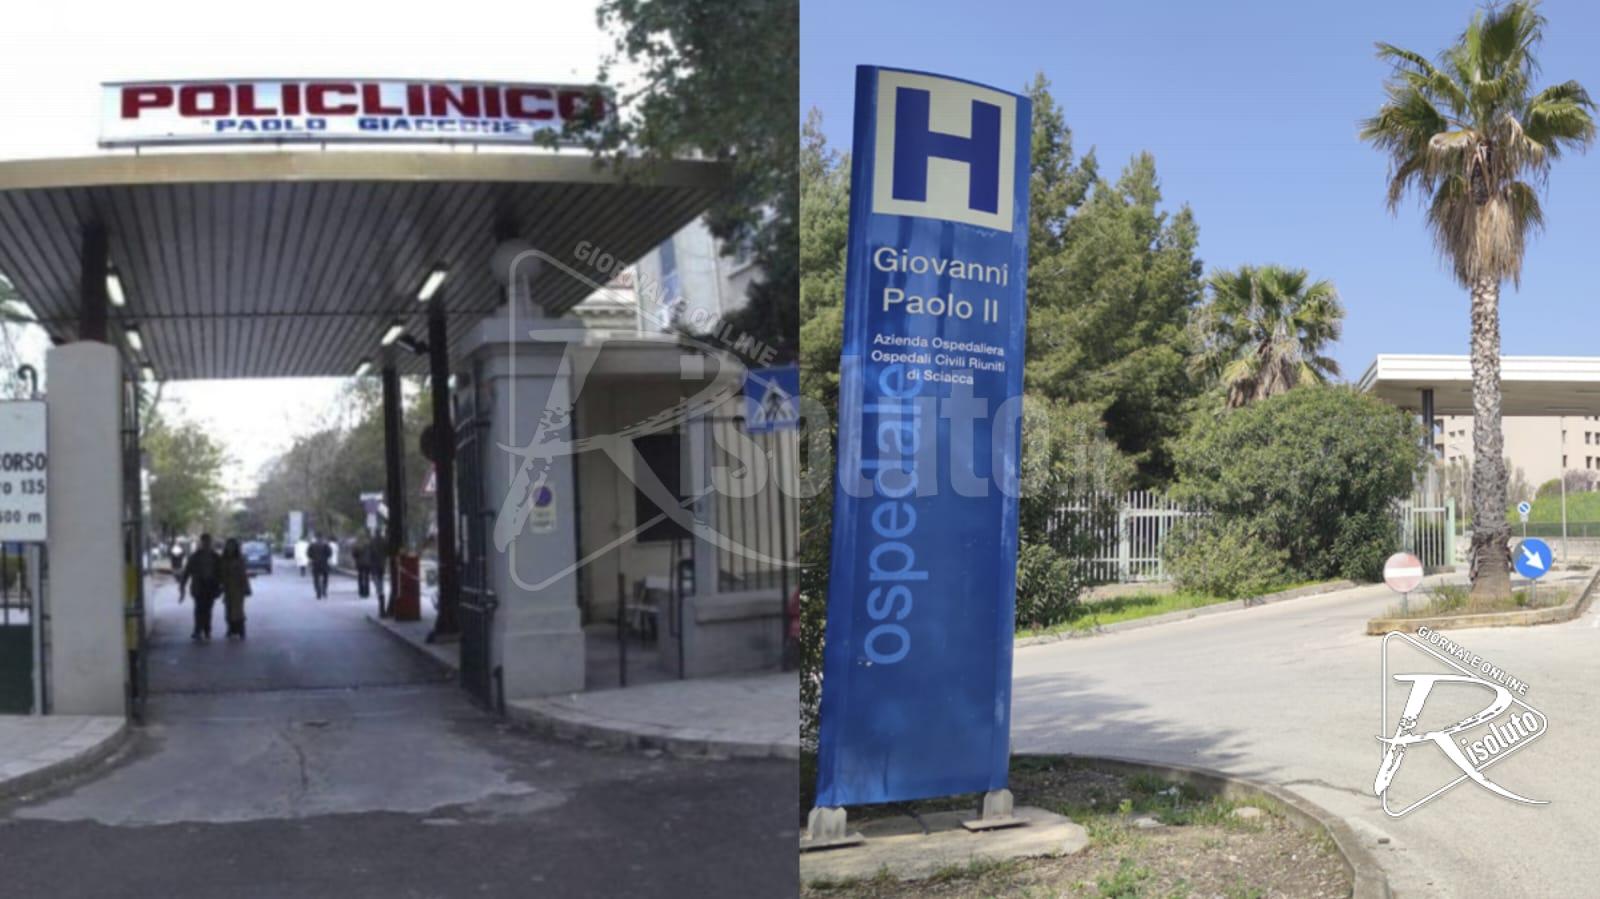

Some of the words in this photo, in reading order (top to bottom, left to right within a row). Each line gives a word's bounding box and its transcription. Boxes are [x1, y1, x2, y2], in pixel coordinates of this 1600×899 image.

[120, 83, 606, 119] POLICLINICO
[892, 86, 1002, 216] H
[873, 247, 1008, 286] Giovanni
[883, 287, 974, 320] Paolo
[871, 351, 931, 365] Ospedali
[935, 355, 965, 368] Civili
[969, 358, 1005, 372] Riuniti
[873, 333, 928, 348] Azienda
[932, 337, 1004, 357] Ospedaliera
[907, 370, 919, 381] di
[923, 370, 974, 385] Sciacca
[28, 513, 42, 523] m
[864, 363, 930, 666] ospedale
